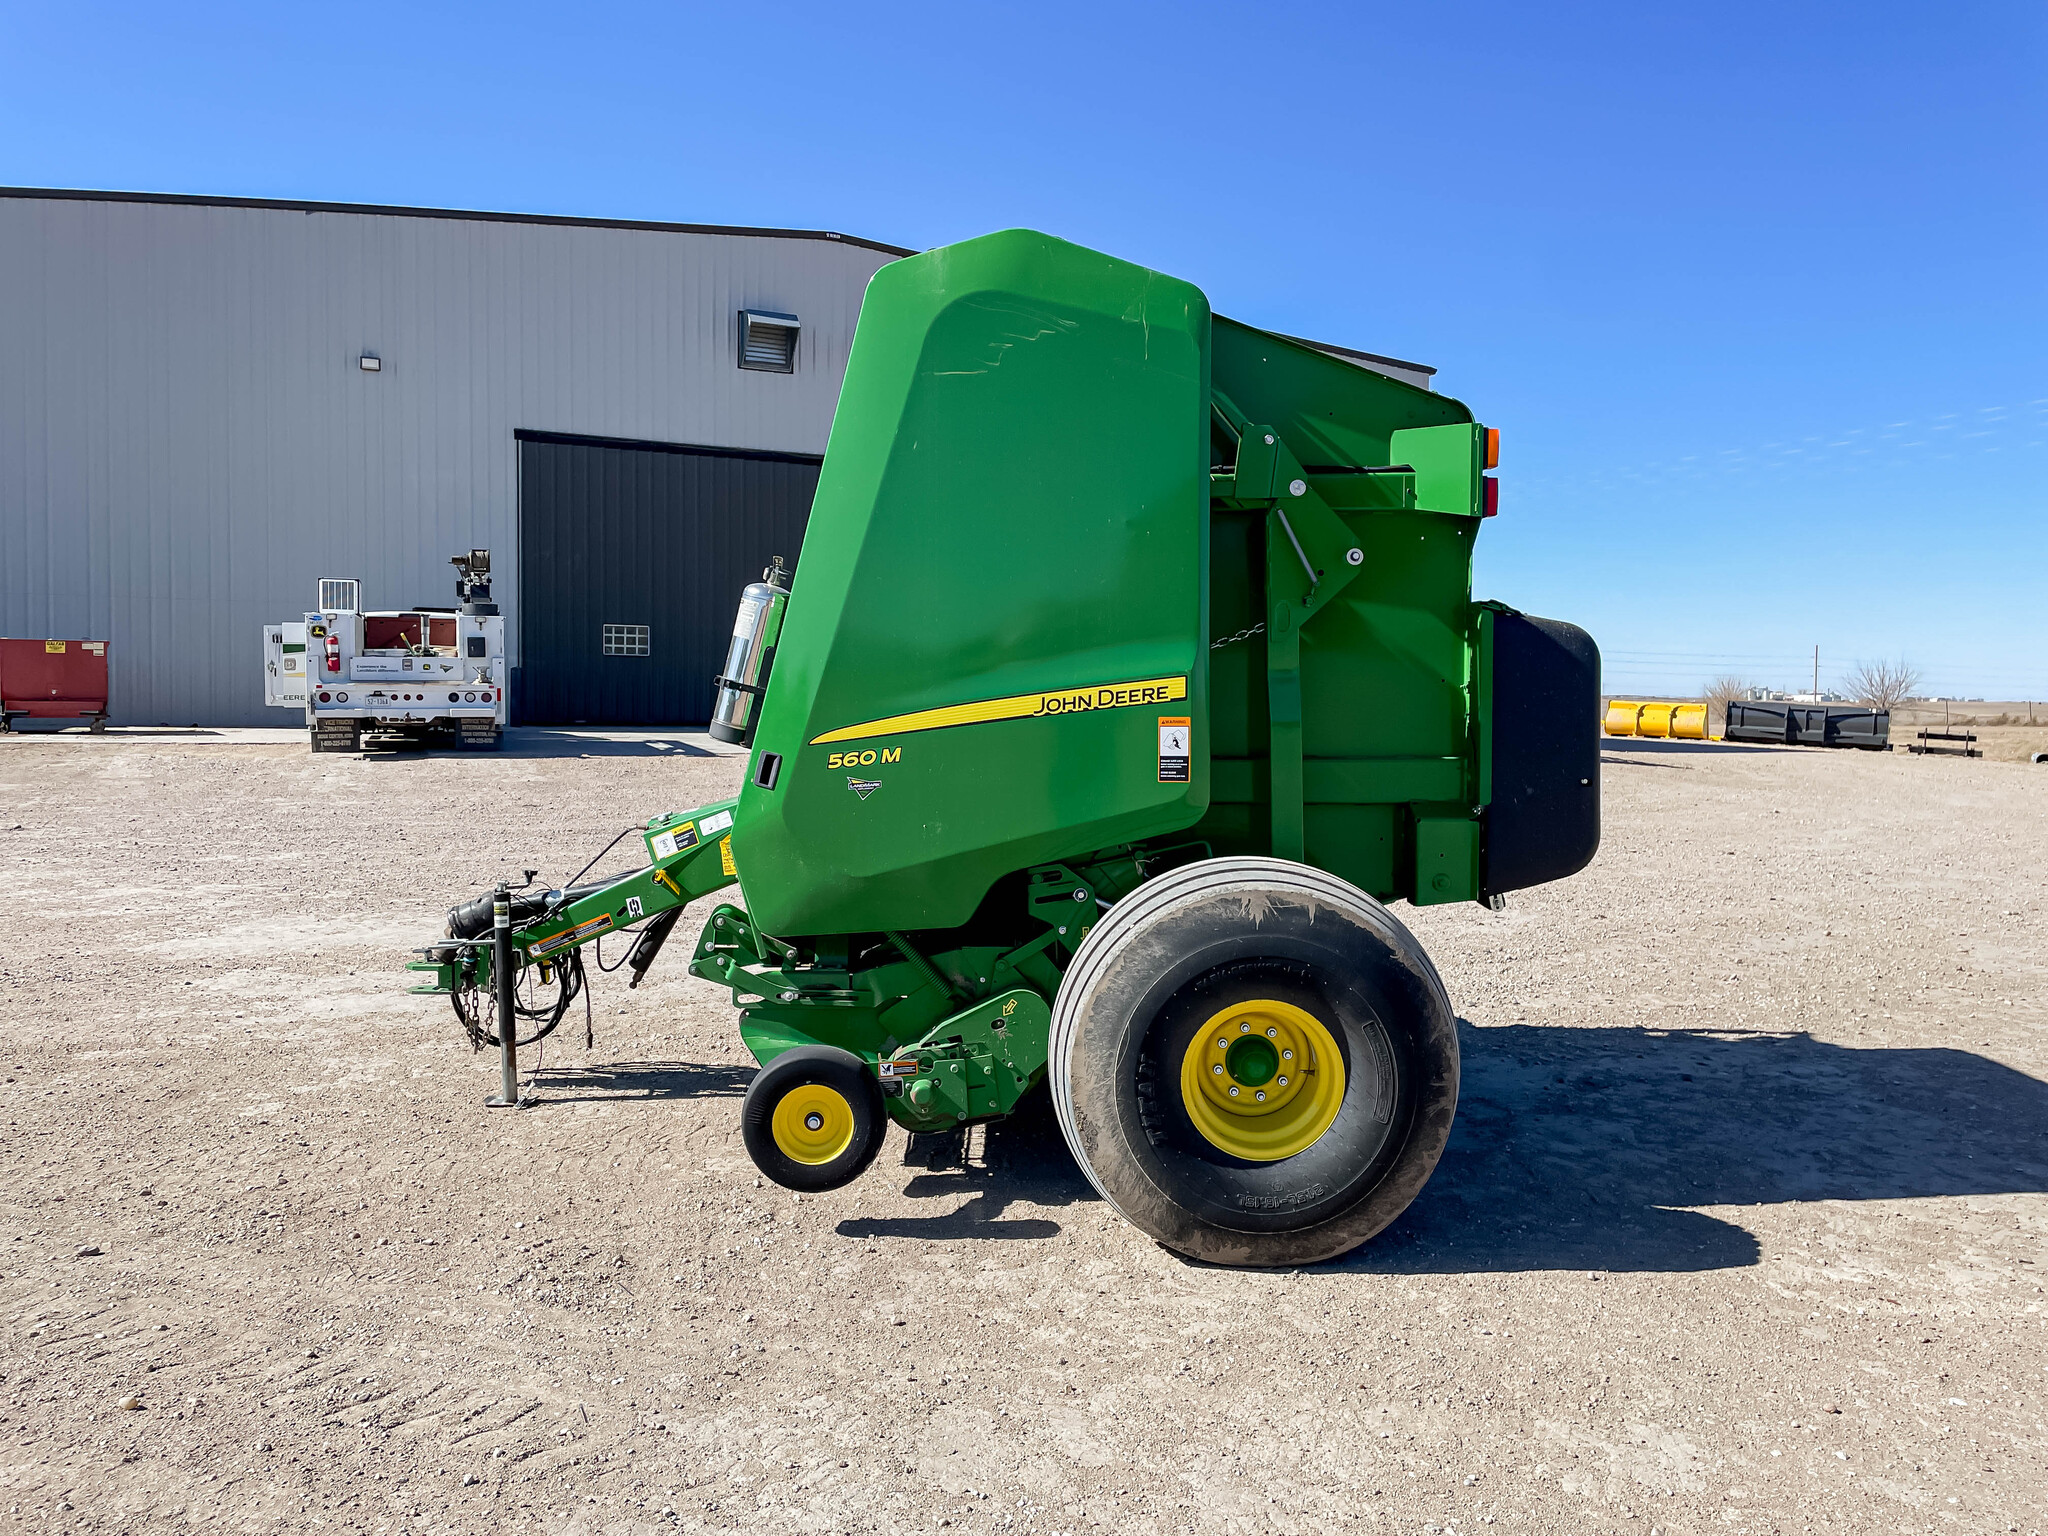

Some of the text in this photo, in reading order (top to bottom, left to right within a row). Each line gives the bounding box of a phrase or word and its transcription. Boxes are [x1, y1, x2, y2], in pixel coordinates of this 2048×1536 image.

[1033, 685, 1169, 714] JOHN DEERE
[827, 746, 902, 769] 560 M
